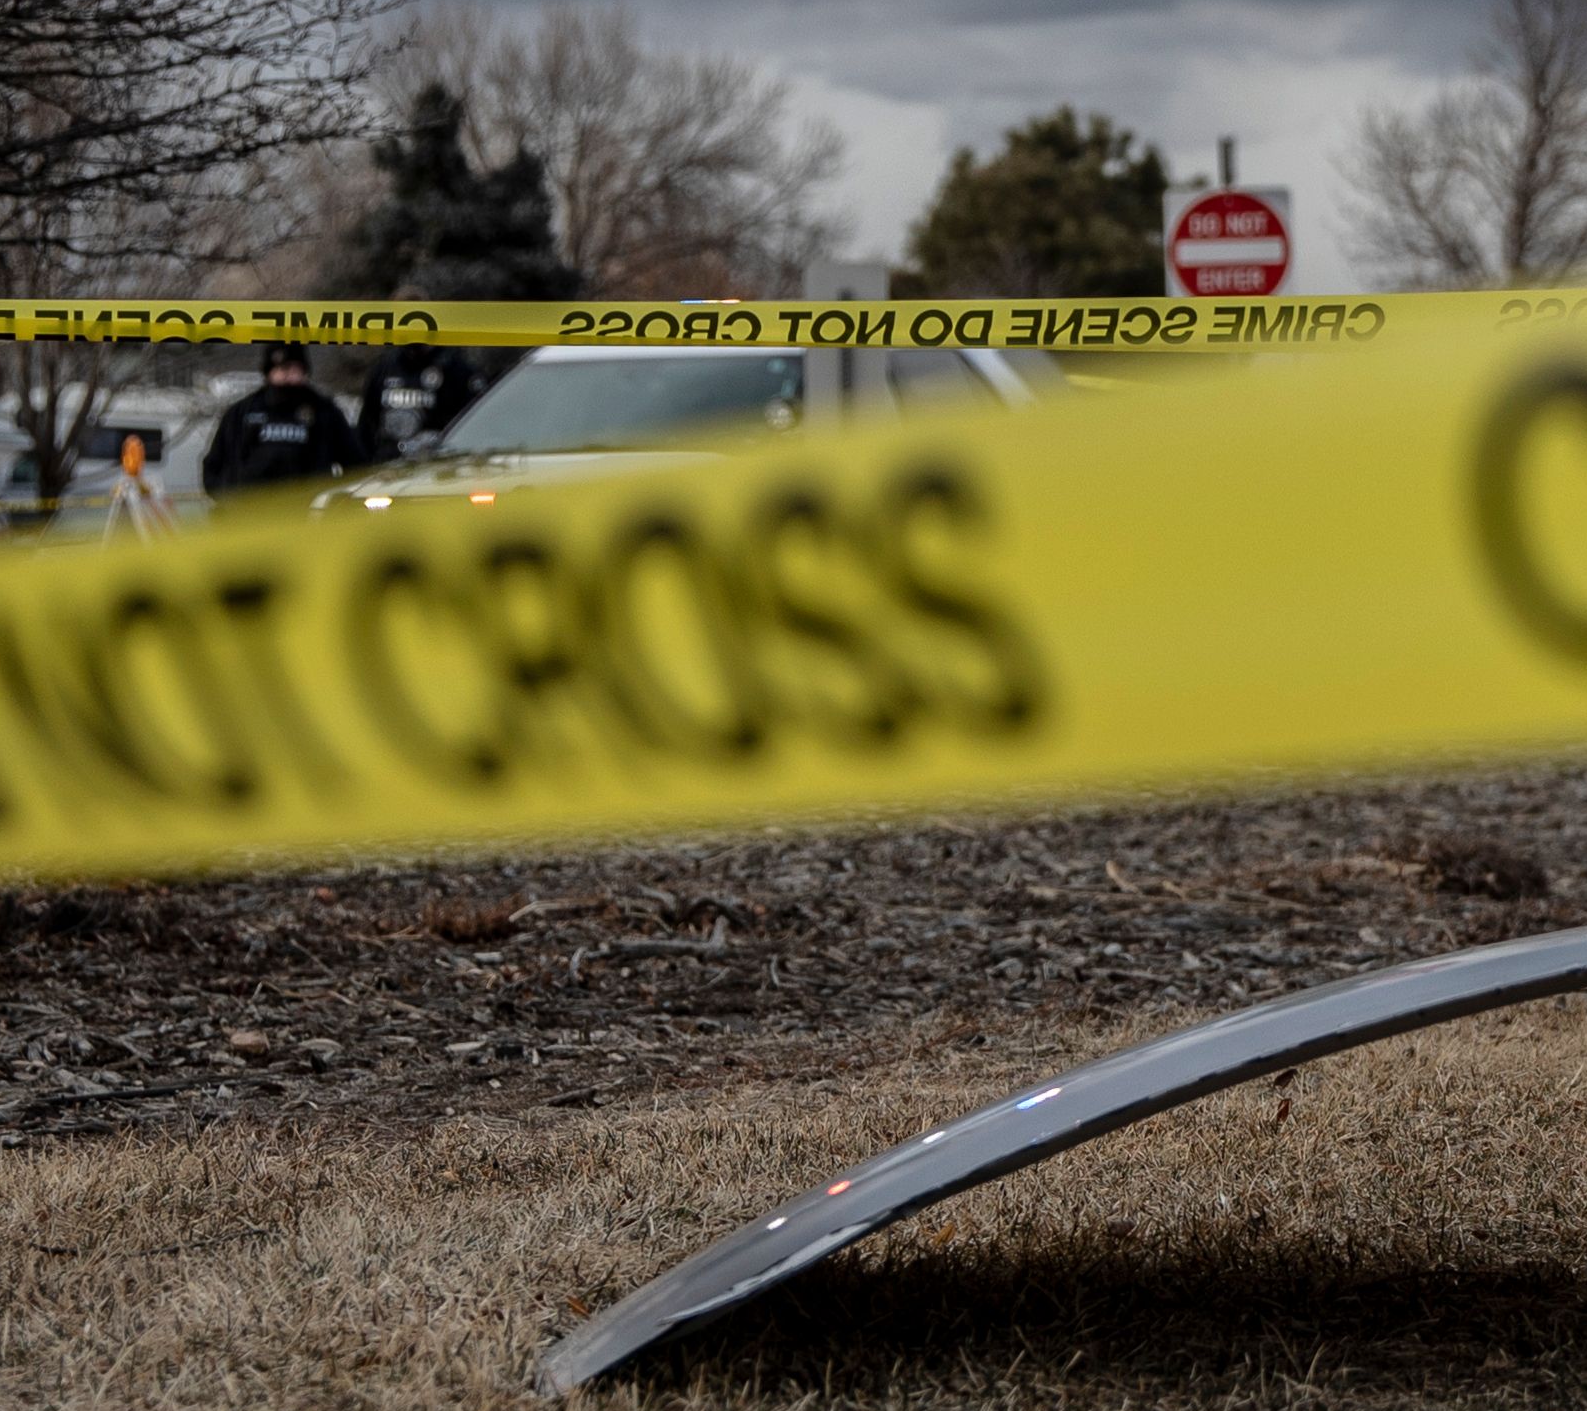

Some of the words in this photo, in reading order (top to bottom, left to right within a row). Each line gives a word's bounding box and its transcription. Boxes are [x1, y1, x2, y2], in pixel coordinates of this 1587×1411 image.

[1189, 213, 1221, 238] DO
[1225, 210, 1268, 236] NOT
[1197, 268, 1265, 293] ENTER
[338, 459, 1053, 785] CROSS
